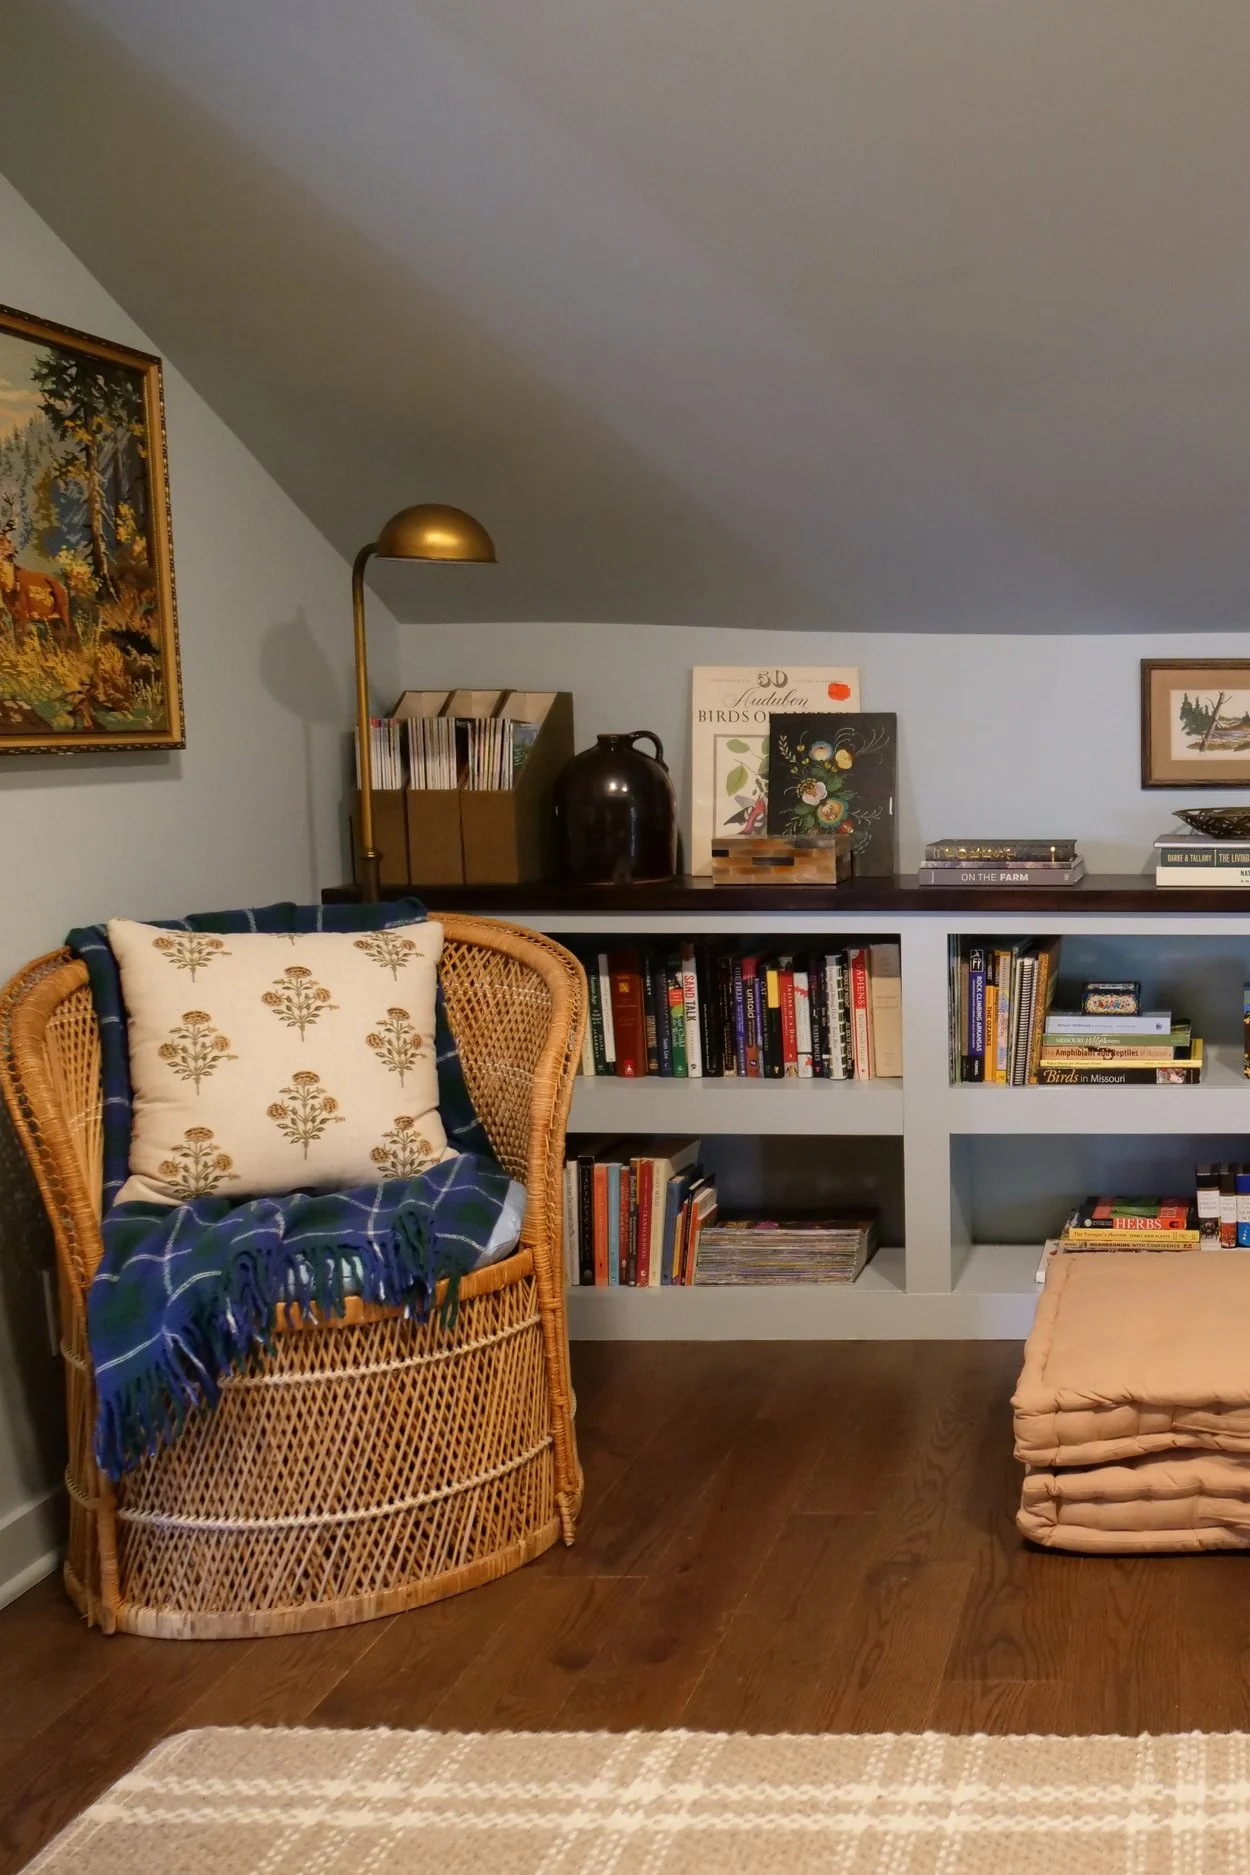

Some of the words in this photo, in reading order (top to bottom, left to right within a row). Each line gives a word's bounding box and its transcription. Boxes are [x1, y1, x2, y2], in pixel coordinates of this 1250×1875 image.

[756, 669, 789, 689] 50
[721, 686, 809, 709] Audubon
[698, 710, 750, 723] BIRDS
[1167, 854, 1183, 862] DARKE
[1190, 854, 1212, 862] TALLAMY
[1219, 853, 1230, 862] THE
[1231, 853, 1249, 862] LIVING
[961, 873, 976, 882] ON
[978, 873, 996, 881] THE
[1000, 873, 1029, 881] FARM
[684, 975, 696, 999] SAND
[735, 982, 743, 1002] FIELD
[856, 964, 866, 1006] SAPIENS
[685, 1000, 697, 1022] TALK
[746, 989, 755, 1018] untold
[678, 1028, 686, 1048] Child
[1055, 1049, 1095, 1058] Amphibians
[1111, 1049, 1139, 1058] Reptiles
[1043, 1069, 1079, 1083] Birds
[1080, 1074, 1089, 1082] in
[1090, 1074, 1126, 1083] Missouri
[1115, 1217, 1163, 1229] HERBS
